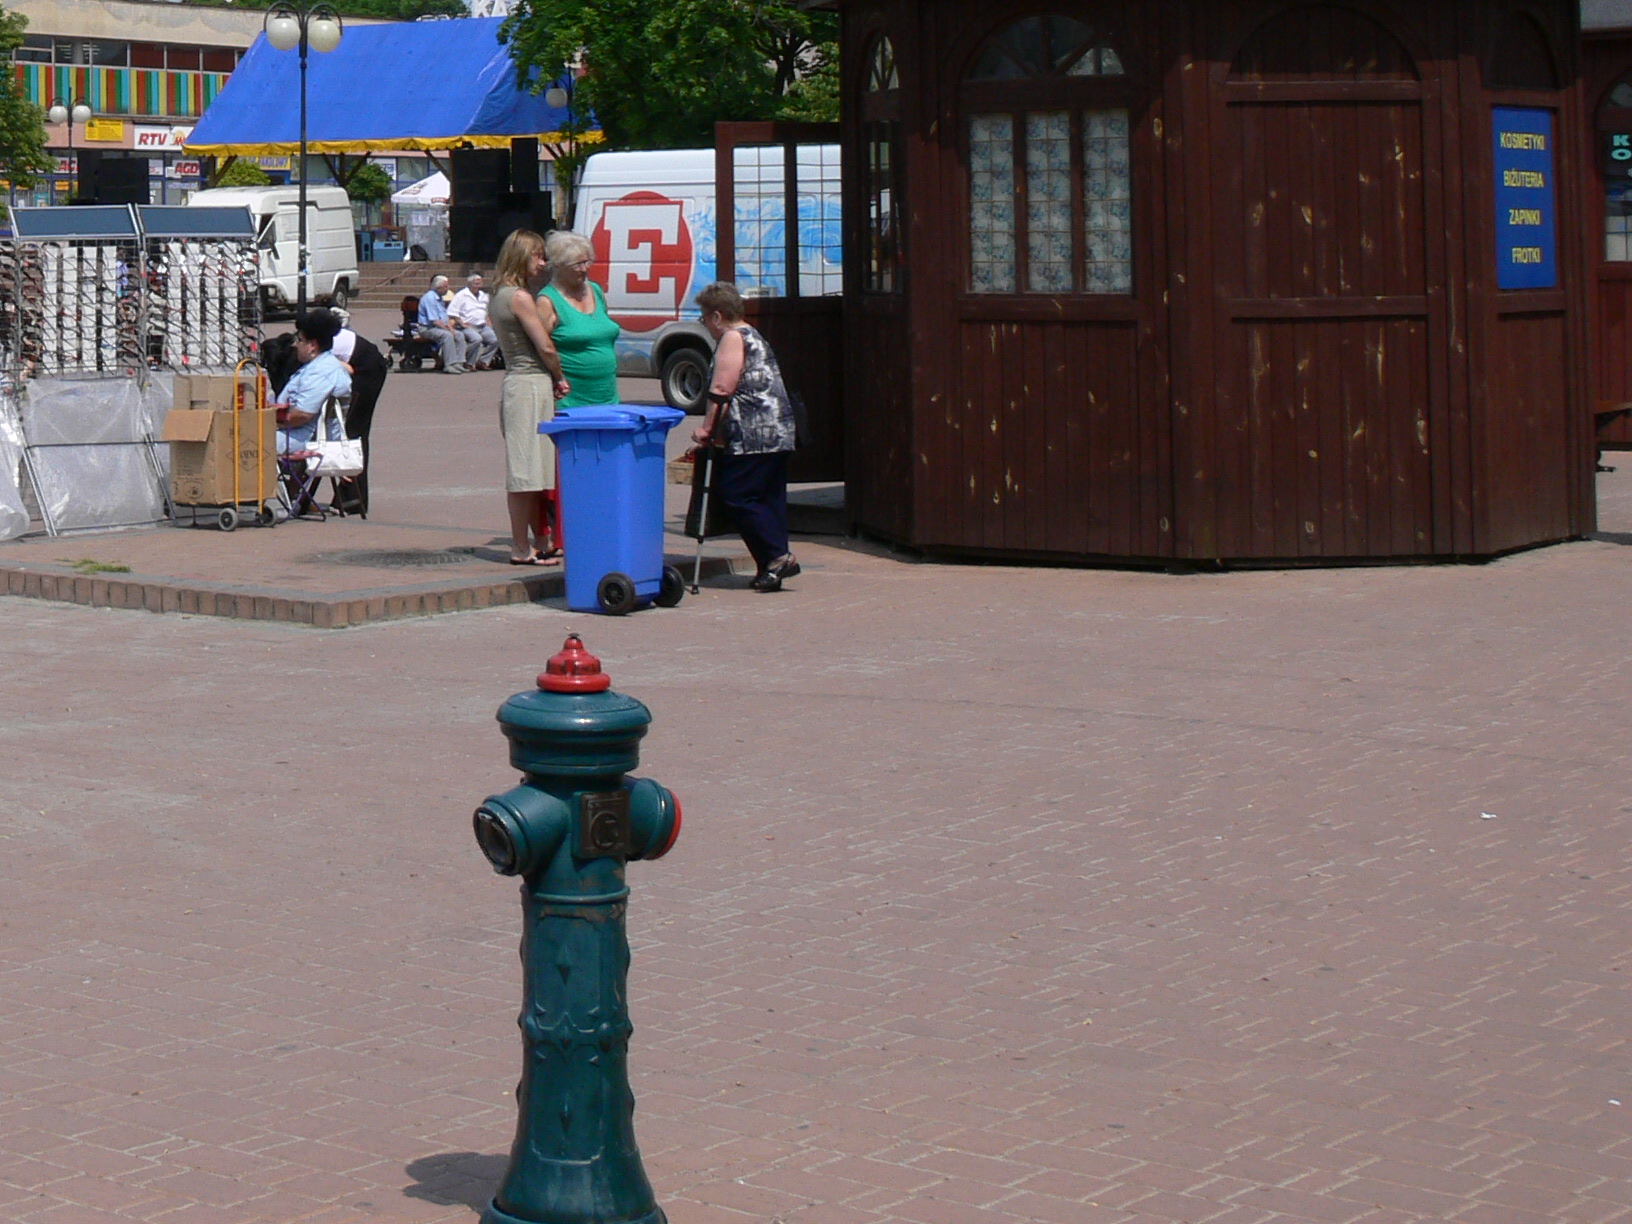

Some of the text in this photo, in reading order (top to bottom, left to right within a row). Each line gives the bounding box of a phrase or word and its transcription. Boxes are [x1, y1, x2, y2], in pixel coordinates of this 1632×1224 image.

[138, 132, 168, 146] RTV
[1500, 132, 1546, 151] KOSMETYKI
[175, 162, 201, 175] AGD
[1508, 209, 1541, 225] ZAPINKI
[1511, 247, 1542, 264] FROTKI
